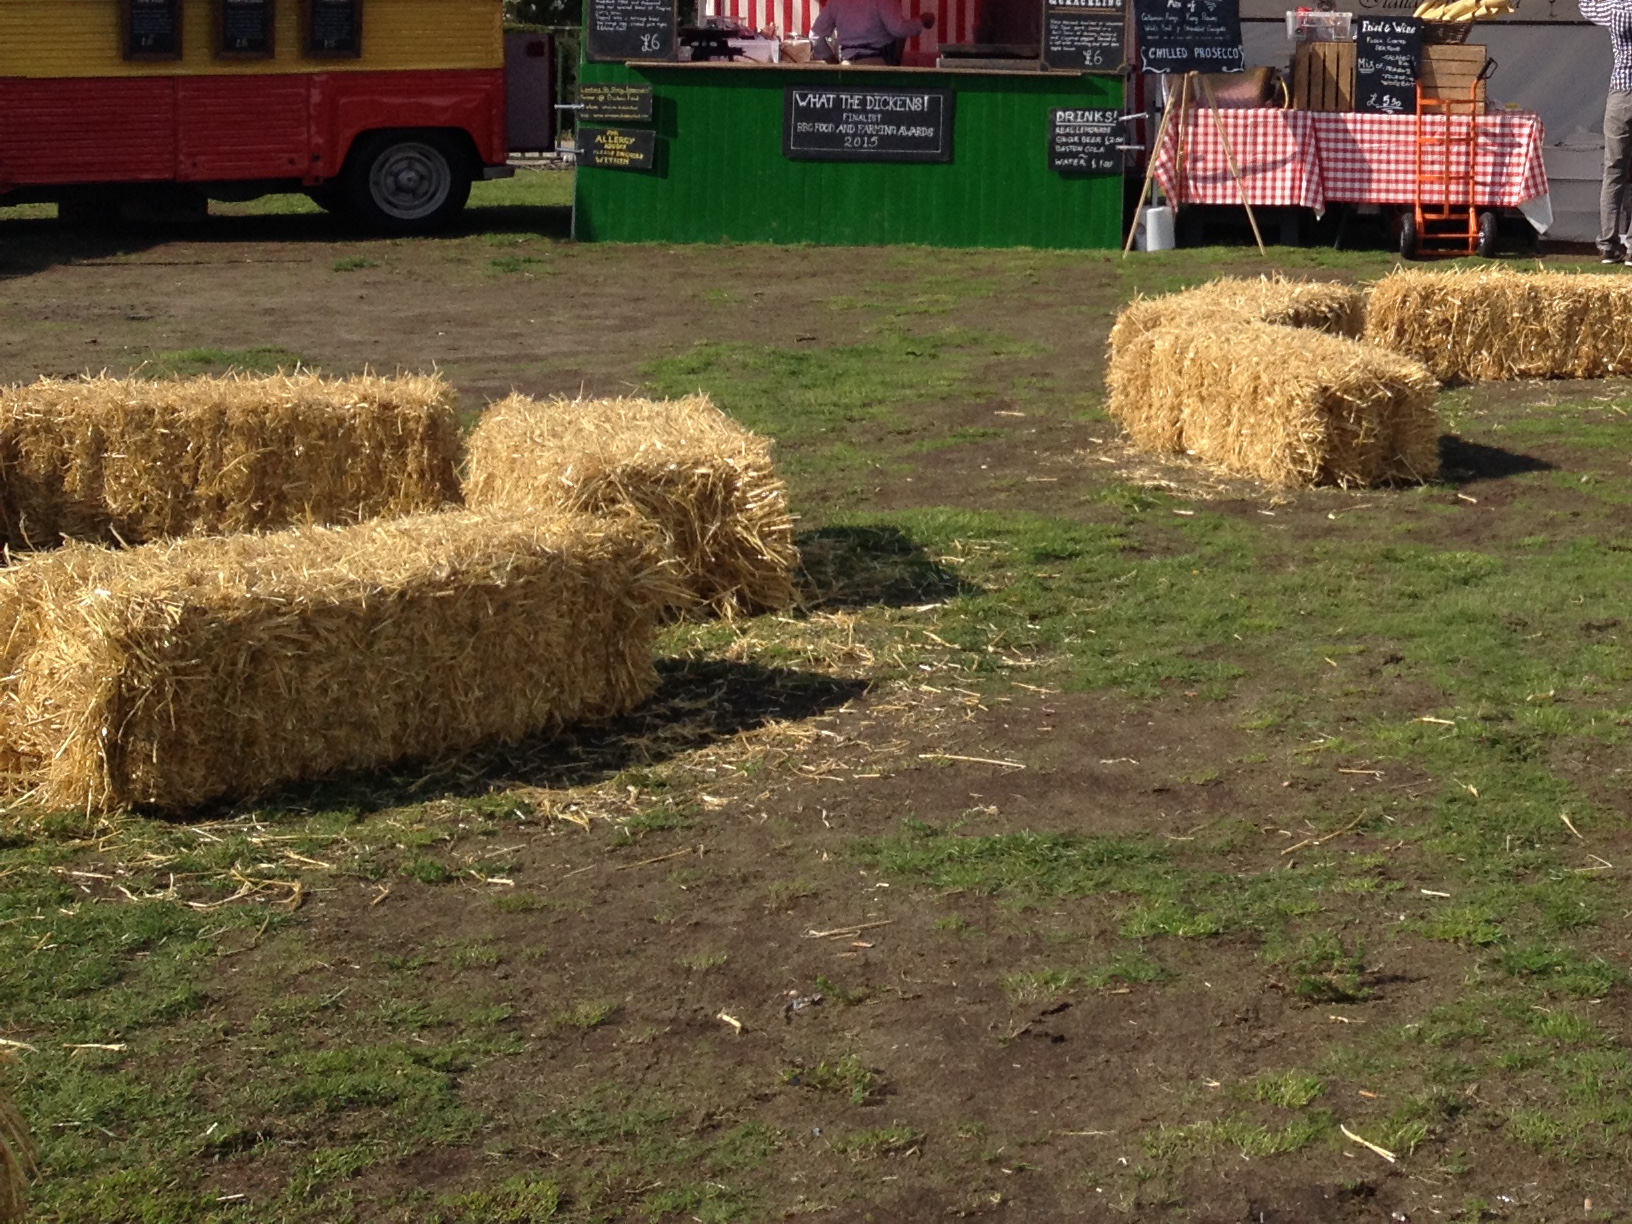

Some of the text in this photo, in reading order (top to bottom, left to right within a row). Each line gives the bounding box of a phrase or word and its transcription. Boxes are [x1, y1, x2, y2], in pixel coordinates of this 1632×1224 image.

[1362, 20, 1384, 33] Fried
[640, 33, 660, 52] £6
[1148, 47, 1240, 59] CHILLED PROSECCO
[795, 93, 929, 112] WHAT THE DICKENS!
[842, 112, 882, 122] FINALIST
[1056, 110, 1118, 125] DRINKS!
[836, 124, 856, 134] AND
[899, 127, 934, 138] AWARDS
[843, 136, 879, 148] 2015
[1054, 158, 1087, 167] WATER
